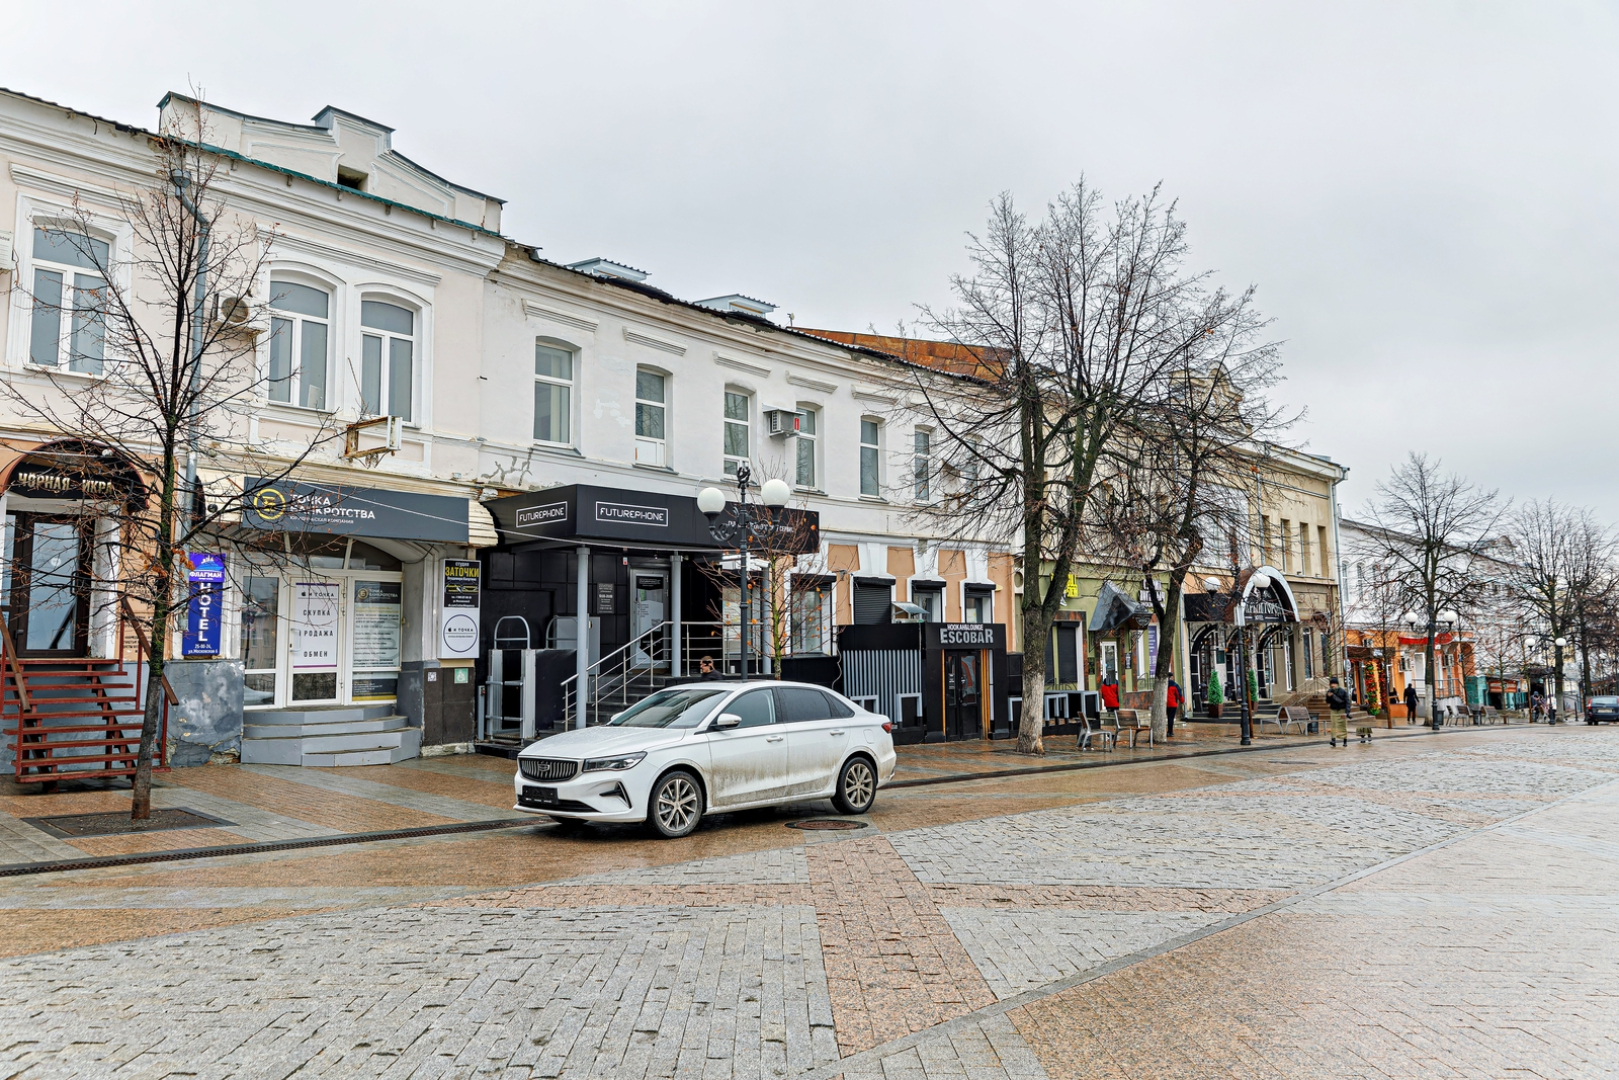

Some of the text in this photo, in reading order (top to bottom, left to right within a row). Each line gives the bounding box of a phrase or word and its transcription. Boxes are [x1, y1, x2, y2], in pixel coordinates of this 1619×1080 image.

[82, 479, 113, 495] ИКРА
[519, 507, 565, 521] FUTUREPHONE
[600, 507, 664, 521] FUTUREPHONE
[445, 566, 479, 577] ЗАТОЧКИ
[198, 582, 212, 642] HOTEL
[940, 628, 994, 643] ESCOBAR
